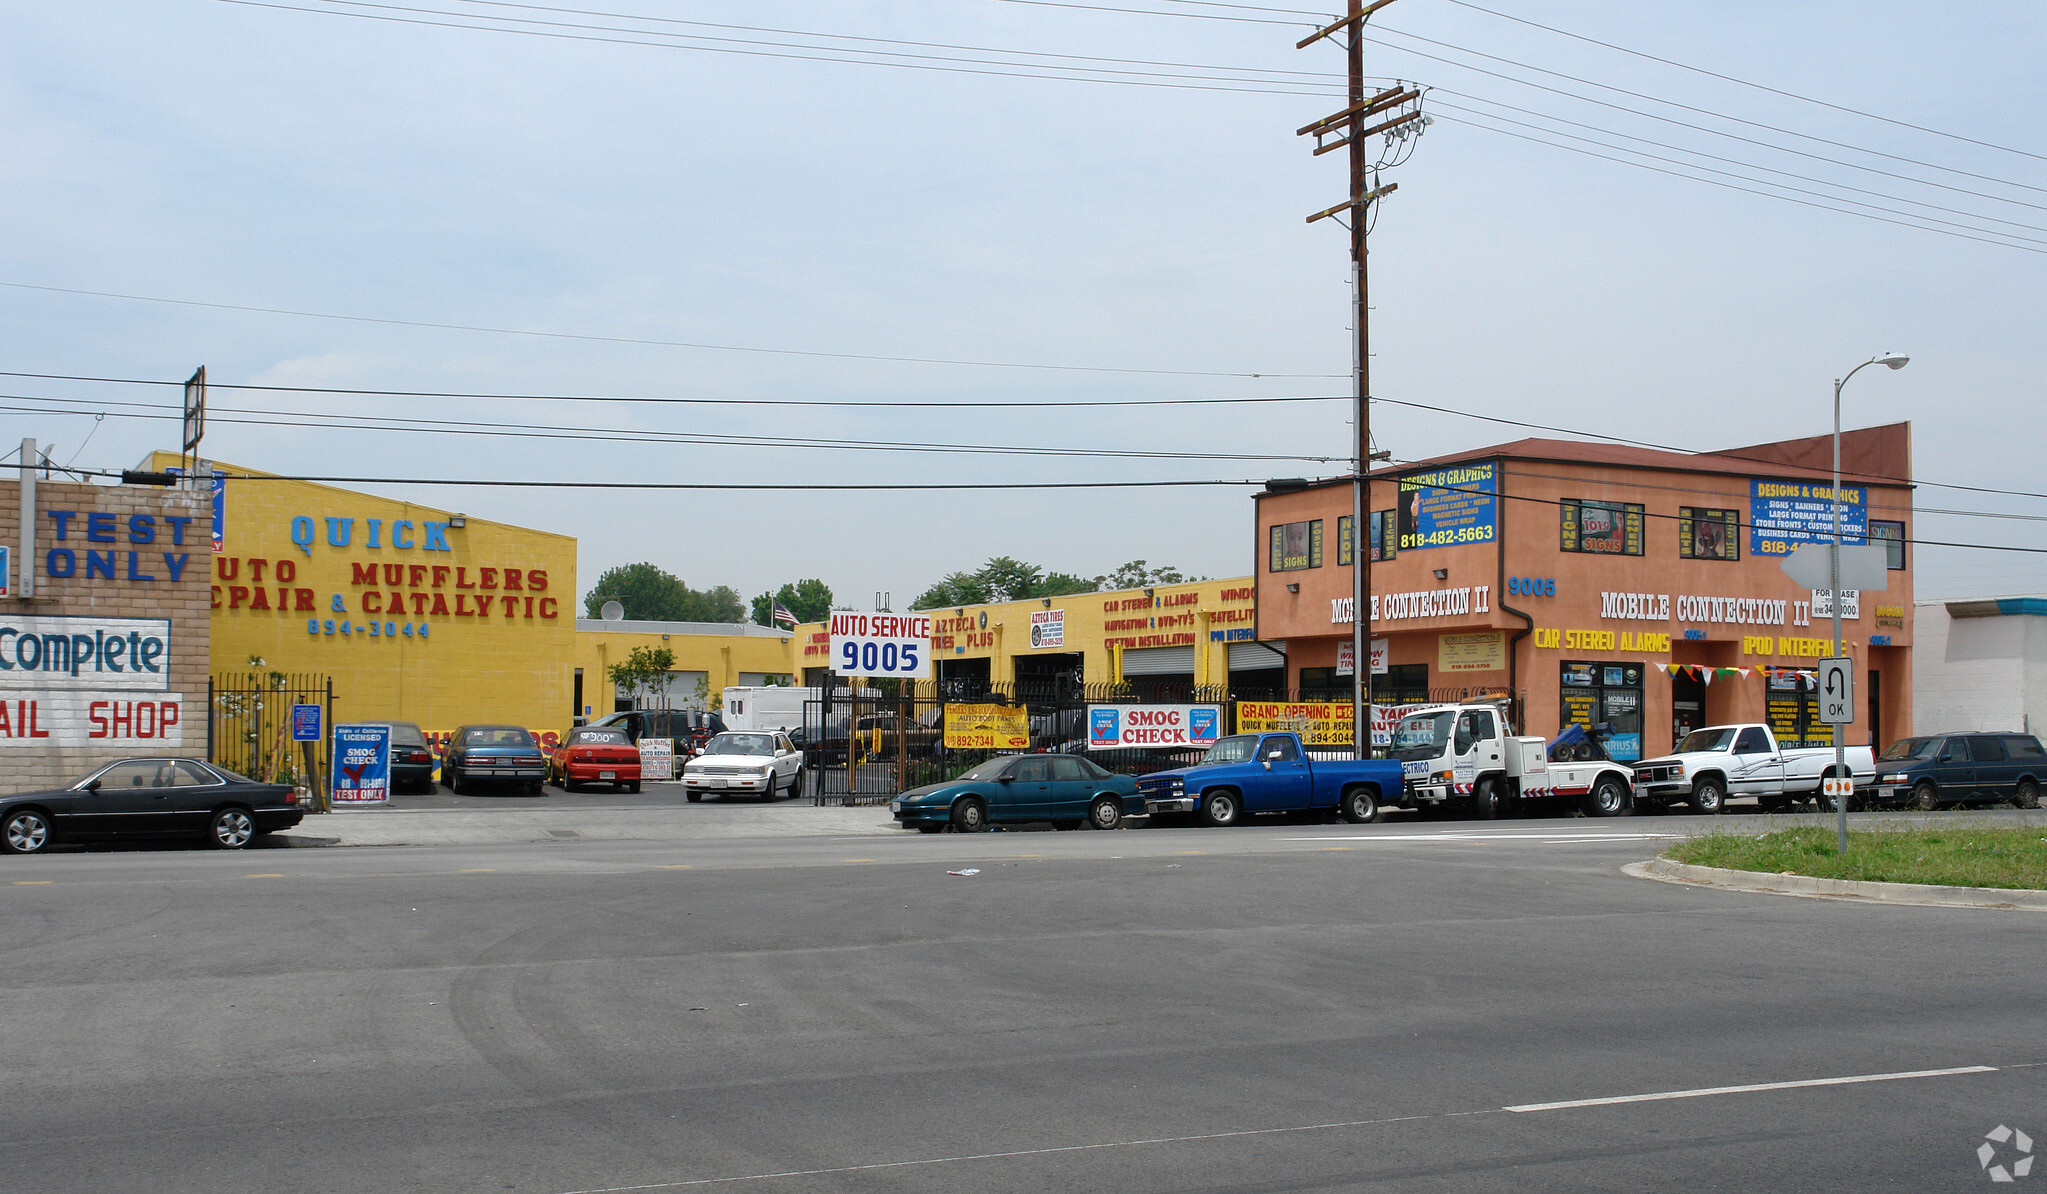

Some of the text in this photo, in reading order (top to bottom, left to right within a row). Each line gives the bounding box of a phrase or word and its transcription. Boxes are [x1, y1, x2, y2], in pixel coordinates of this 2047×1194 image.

[1401, 464, 1492, 491] DESIGNS & GRAPHICS
[1454, 483, 1480, 493] BANNERS
[1758, 483, 1859, 504] DESIGNS & GRAHICS
[1422, 497, 1439, 505] LARGE
[1440, 494, 1462, 503] FORMAT
[1423, 498, 1490, 513] BUSINESS CARDS NEON
[1769, 501, 1848, 512] SIGNS BANNERS NON
[1432, 507, 1479, 519] MAGNETIC SIGNS
[1791, 511, 1816, 520] FORMAT
[1818, 512, 1848, 521] PRINNG
[48, 510, 192, 545] TEST
[1435, 517, 1476, 528] VEHICLE WRAP
[1562, 504, 1576, 549] SIGNS
[1626, 506, 1639, 552] BANNERS
[1756, 519, 1862, 532] STORE FRONTS CUSTOM TICKERS
[291, 515, 451, 556] QUICK
[1342, 518, 1352, 563] NEON
[1400, 524, 1493, 548] 818-482-5663
[1758, 529, 1788, 537] BUSINESS
[1790, 530, 1810, 539] CARDS
[1872, 527, 1897, 539] SIGNS
[1584, 538, 1621, 552] SIGNS
[47, 548, 189, 582] ONLY
[1284, 555, 1307, 568] SIGNS
[217, 557, 548, 591] UTO MUFFLERS
[1509, 576, 1556, 596] 9005
[1816, 589, 1855, 598] FOR ASE
[211, 585, 558, 619] EPAIR & CATALYTIC
[1104, 592, 1199, 612] CAR STEREO & ALARMS
[1384, 587, 1470, 620] CONNECTION
[1475, 586, 1488, 613] II
[1600, 592, 1809, 626] MOBILE CONNECTION II
[1032, 611, 1063, 624] AZTECA TIRES
[1210, 608, 1254, 623] SATELLIT
[1876, 605, 1904, 617] SIGNS
[307, 619, 430, 638] 894-3044
[831, 615, 930, 638] AUTO SERVICE
[935, 616, 975, 633] AZTECA
[1105, 618, 1147, 631] NAVIGATION
[1150, 617, 1155, 628] &
[930, 632, 993, 649] TIRES PLUS
[1104, 632, 1195, 649] CUSTOM INSTALLATION
[1534, 628, 1670, 652] CAR STEREO ALARMS
[0, 627, 164, 677] Complete
[842, 641, 918, 671] 9005
[1241, 704, 1279, 719] GRAND
[1284, 705, 1330, 719] OPENING
[1828, 703, 1844, 716] OK
[89, 701, 179, 738] SHOP
[1128, 711, 1180, 726] SMOG
[1242, 720, 1261, 730] QUICK
[1266, 721, 1300, 731] MUFFLERS
[1313, 721, 1329, 730] AUTO
[957, 735, 994, 746] 892-7348
[1122, 728, 1186, 743] CHECK
[347, 748, 376, 756] SMOG
[1603, 740, 1632, 751] SIRIUS
[343, 756, 378, 764] CHECK
[336, 789, 384, 799] TEST ONLY
